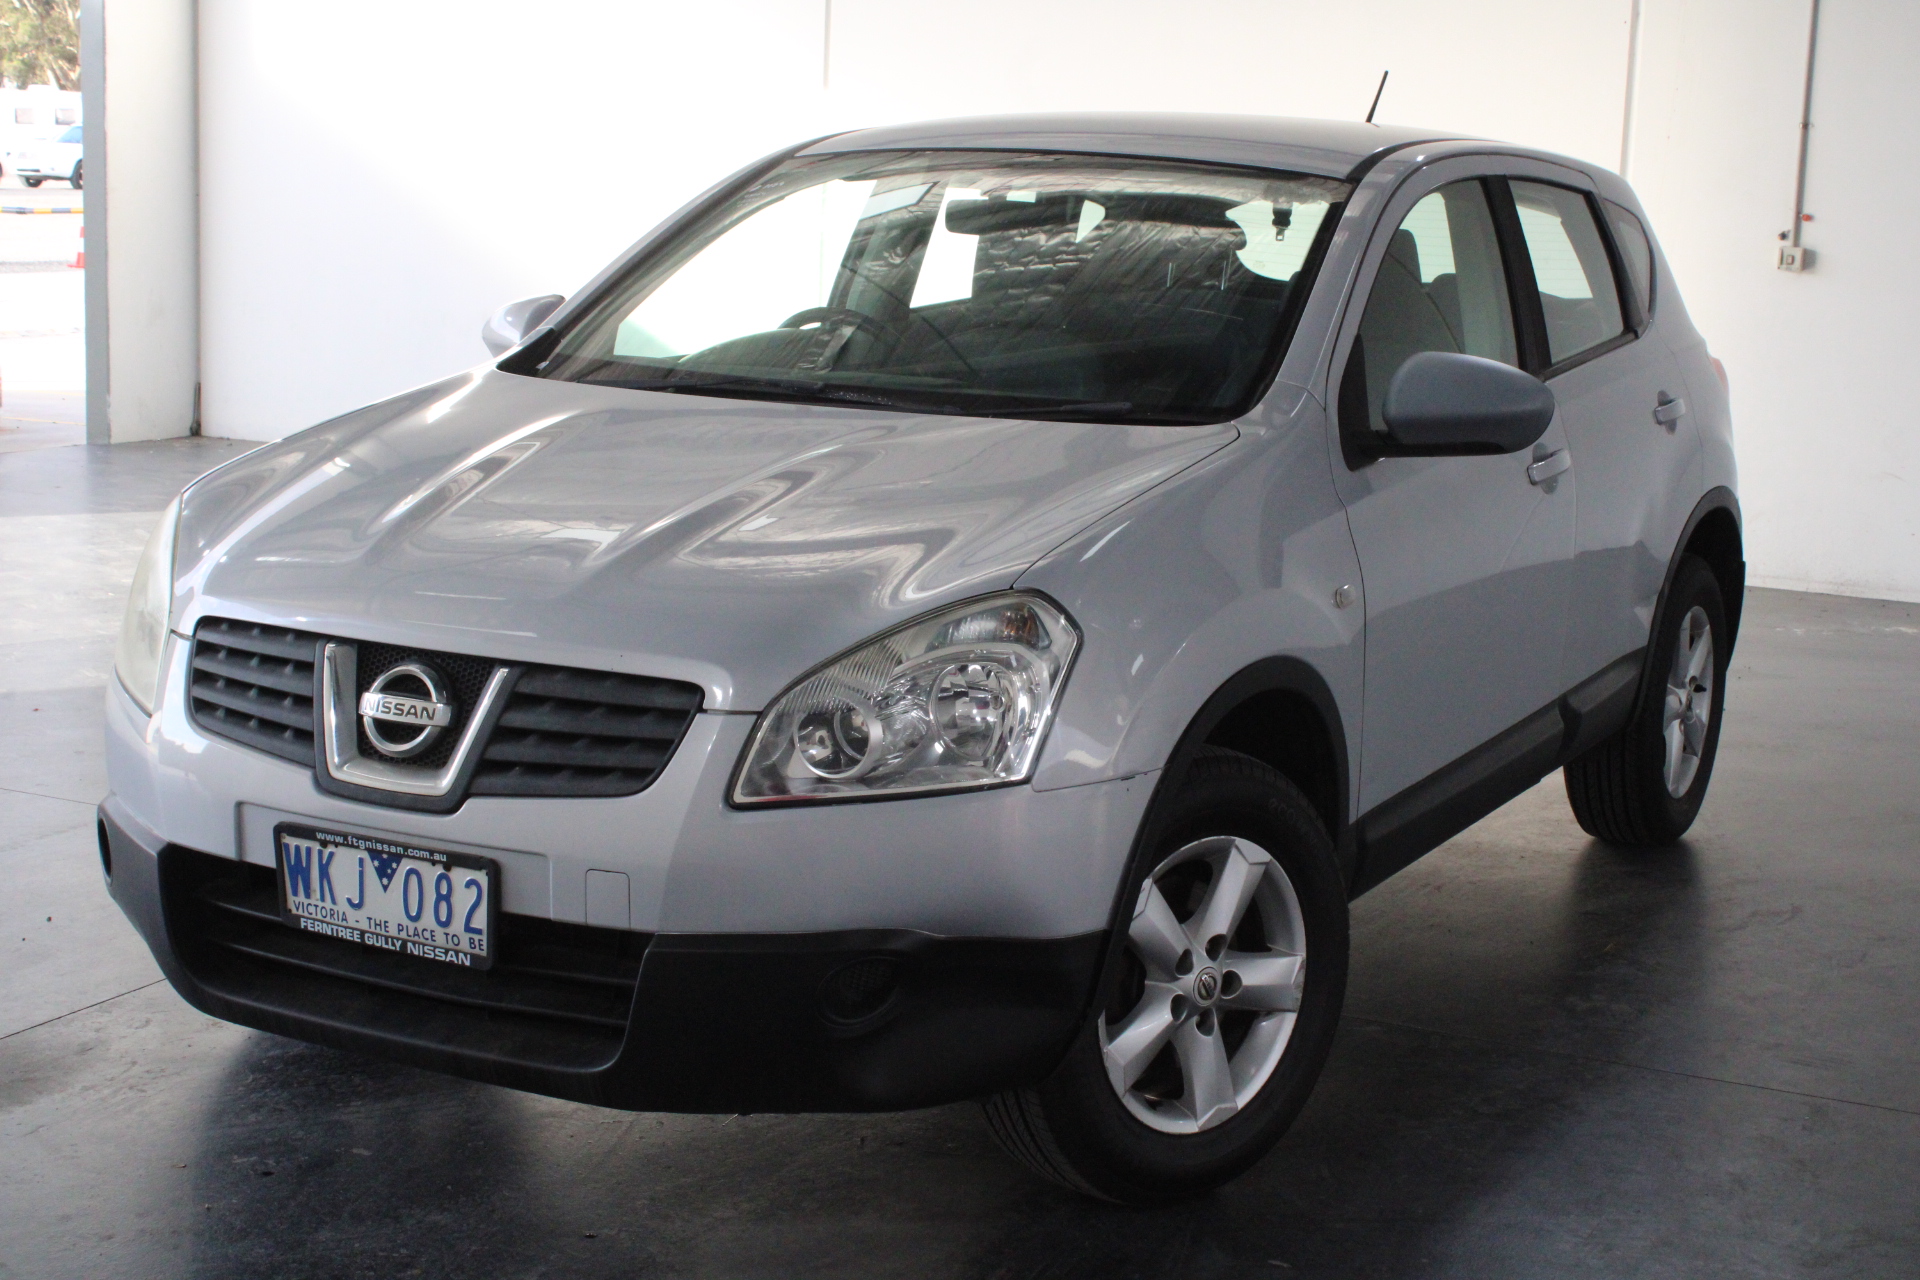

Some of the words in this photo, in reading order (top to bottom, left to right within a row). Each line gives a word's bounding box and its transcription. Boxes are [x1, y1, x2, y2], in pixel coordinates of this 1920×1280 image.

[364, 697, 436, 721] NISSAN
[316, 831, 447, 862] www.ftgnissan.com.au
[283, 841, 365, 910] WKJ
[402, 866, 483, 936] 082
[293, 900, 348, 924] VICTORIA
[366, 916, 389, 933] THE
[397, 924, 437, 942] PLACE
[443, 932, 460, 947] TO
[469, 938, 485, 952] BE
[300, 917, 361, 942] FERNTREE
[364, 932, 402, 951] GULLY
[407, 941, 471, 967] NISSAN
